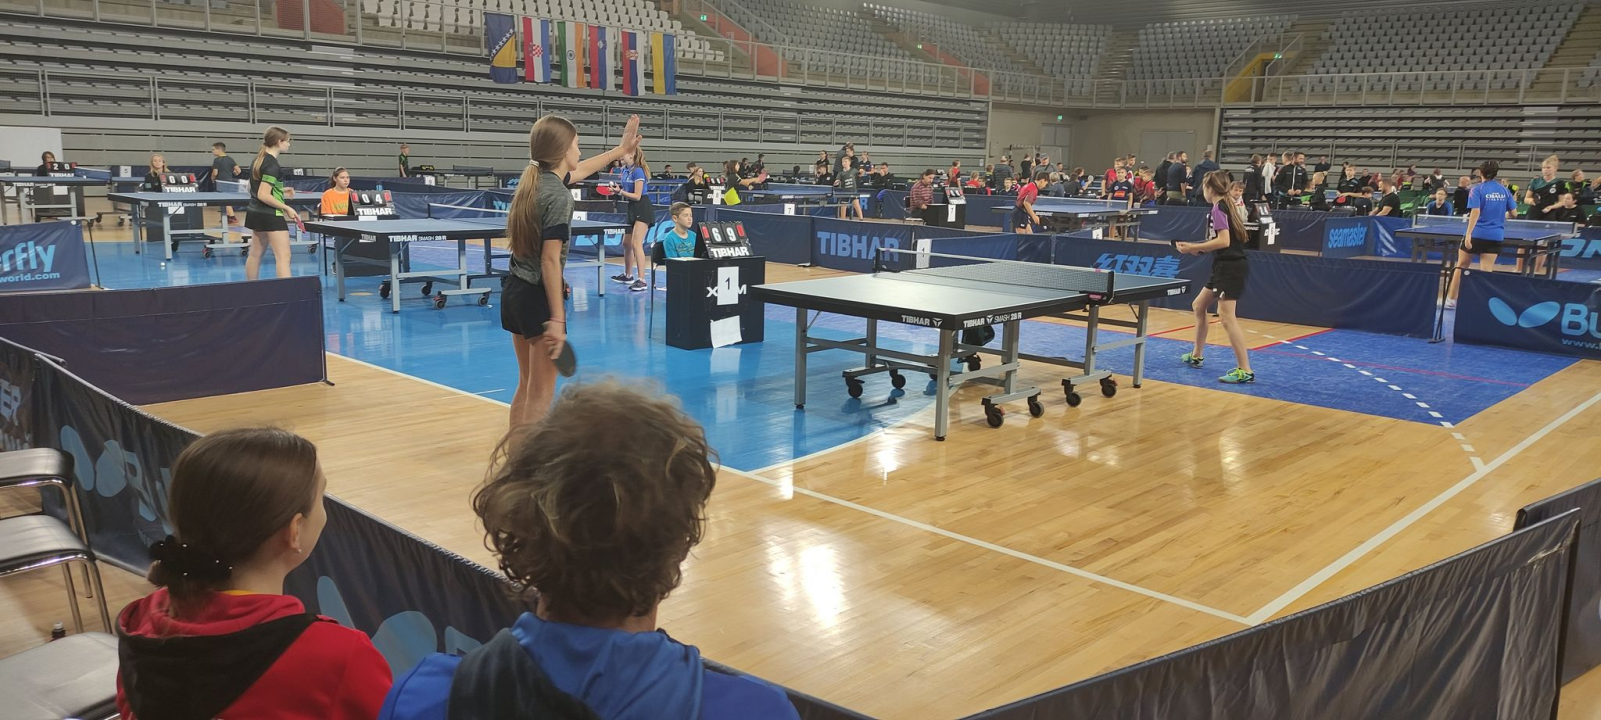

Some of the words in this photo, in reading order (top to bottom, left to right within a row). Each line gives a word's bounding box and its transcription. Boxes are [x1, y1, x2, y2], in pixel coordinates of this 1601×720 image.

[168, 175, 176, 184] 0
[181, 175, 188, 184] 0
[361, 193, 370, 204] 0
[375, 193, 383, 205] 4
[356, 207, 393, 216] TIBHAR
[388, 234, 418, 243] TIBHAR
[711, 227, 722, 242] 6
[726, 227, 737, 242] 9
[1328, 222, 1368, 249] seamaster
[710, 246, 750, 258] TIBHAR
[817, 231, 900, 263] TIBHAR
[725, 277, 731, 291] 1
[901, 314, 931, 327] TIBHAR
[963, 317, 986, 329] TIBHAR
[994, 313, 1010, 324] SMASH
